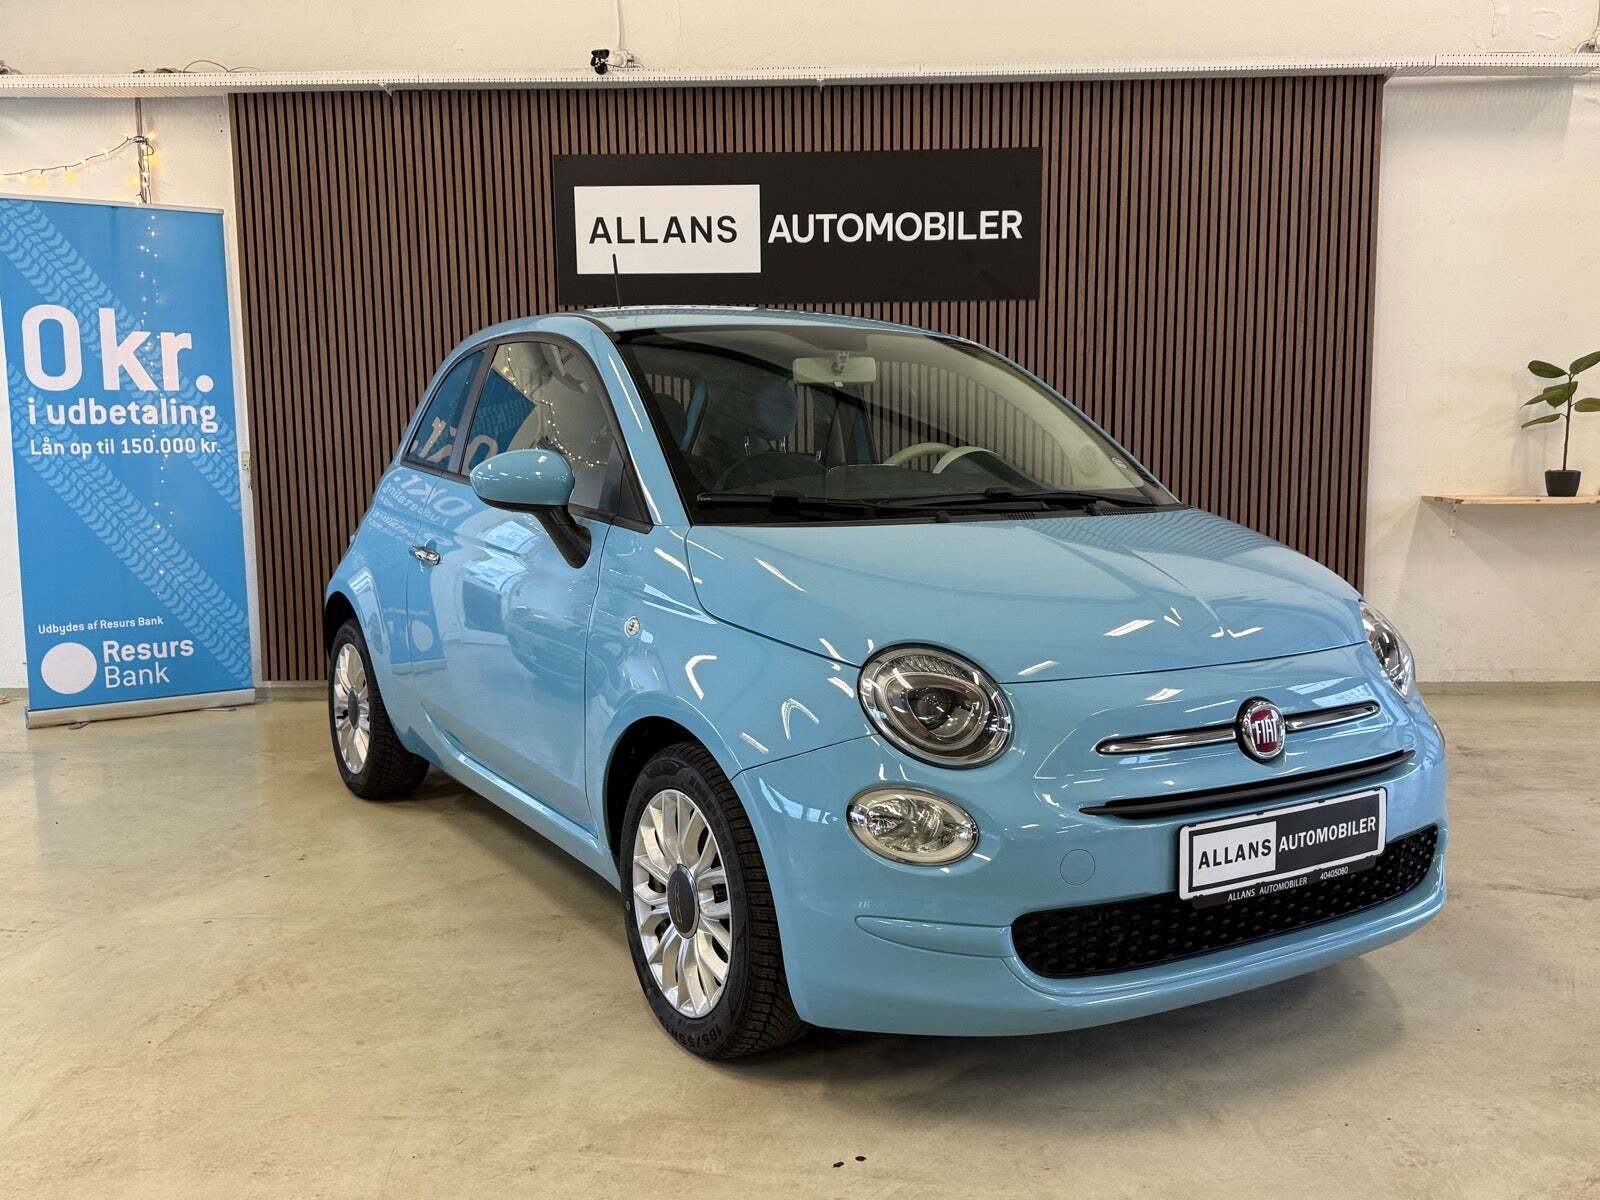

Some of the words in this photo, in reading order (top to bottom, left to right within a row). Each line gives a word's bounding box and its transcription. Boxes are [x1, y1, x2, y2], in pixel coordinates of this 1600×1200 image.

[588, 215, 738, 245] ALLANS
[767, 209, 1023, 244] AUTOMOBILER
[22, 304, 83, 391] 0
[99, 307, 214, 393] kr.
[28, 397, 37, 425] i
[46, 398, 219, 433] udbetaling
[30, 436, 65, 456] Lån
[69, 440, 92, 459] op
[96, 437, 114, 454] til
[121, 437, 196, 454] 150.000
[200, 437, 221, 453] kr.
[38, 622, 85, 635] Udbydes
[87, 620, 98, 630] af
[101, 618, 136, 629] Resurs
[138, 615, 164, 626] Bank
[102, 639, 195, 663] Resurs
[104, 661, 170, 689] Bank
[1254, 719, 1277, 744] FIAT
[1198, 838, 1272, 870] ALLANS
[1278, 815, 1377, 853] AUTOMOBILER
[1227, 888, 1256, 902] ALLANS
[1258, 876, 1308, 896] AUTOMOBILER
